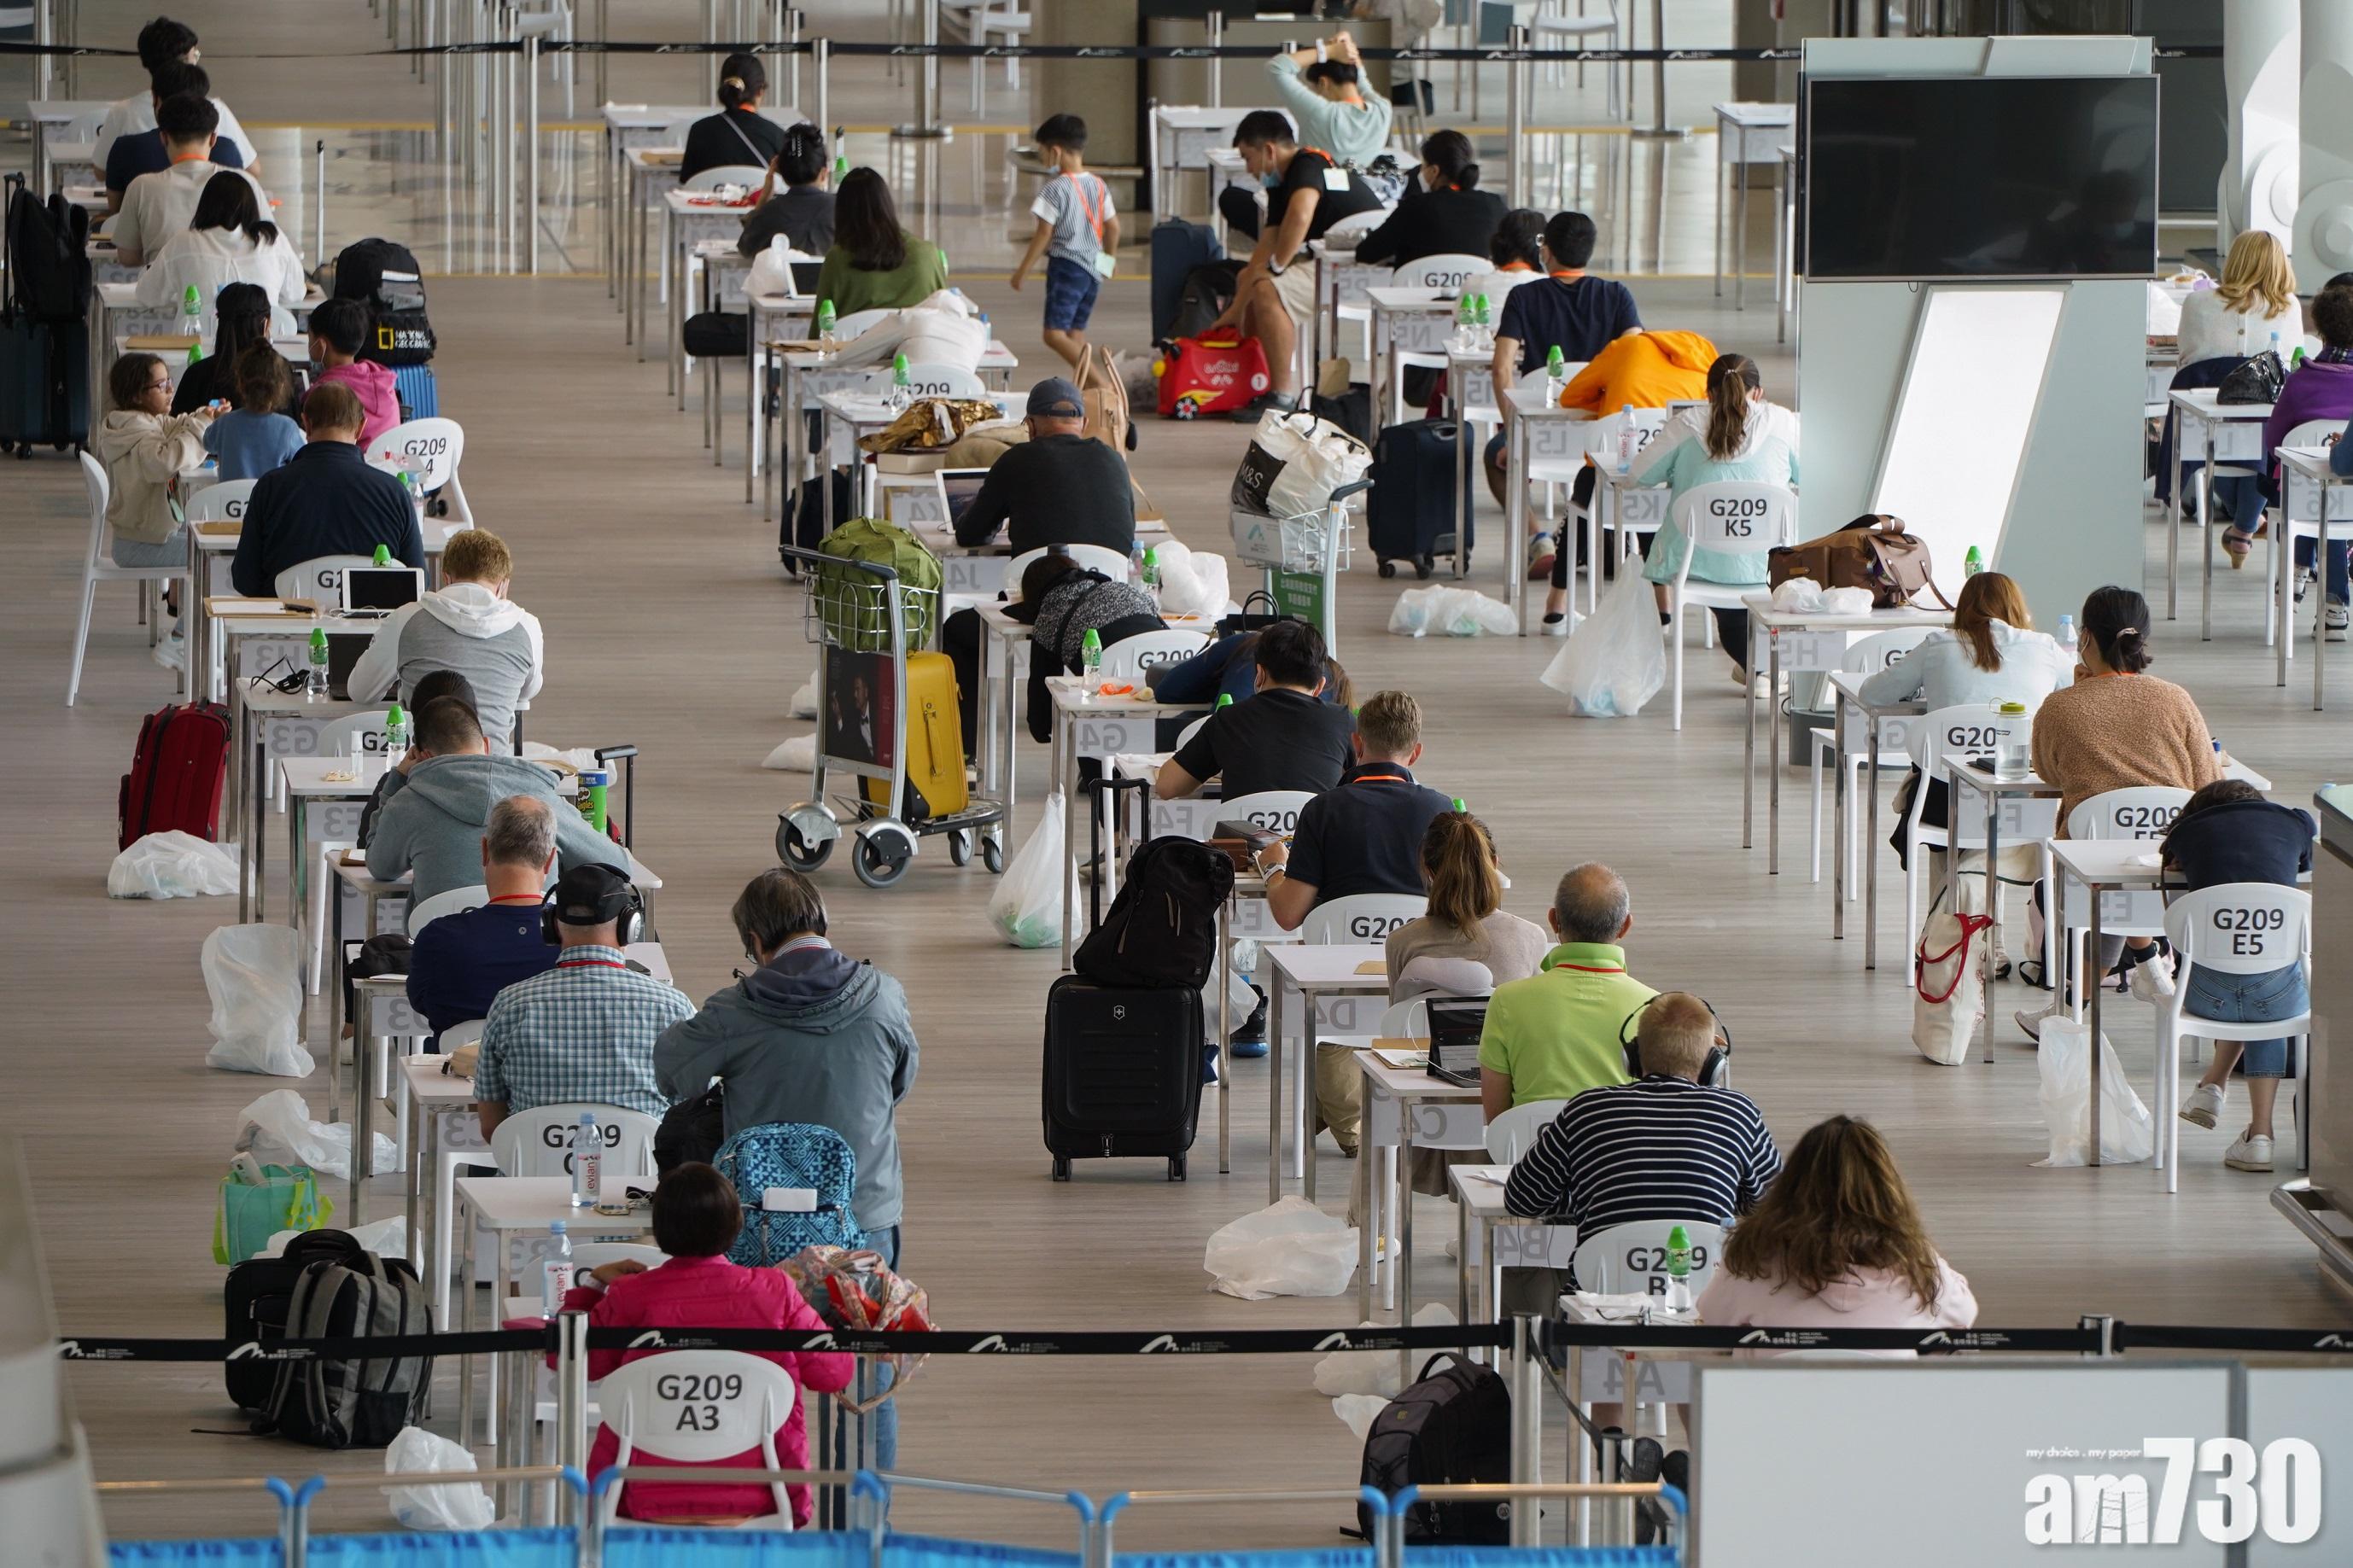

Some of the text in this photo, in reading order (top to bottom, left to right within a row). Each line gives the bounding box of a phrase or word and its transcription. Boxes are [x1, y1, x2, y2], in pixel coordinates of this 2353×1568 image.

[907, 382, 949, 395] 209
[404, 438, 447, 456] G209
[1241, 463, 1264, 489] M&S
[1710, 498, 1767, 516] G209
[1725, 519, 1752, 537] K5
[1947, 726, 1996, 747] G20
[1247, 811, 1299, 832] G20
[1351, 916, 1416, 939] G20
[2213, 908, 2285, 930] G209
[2233, 934, 2264, 955] E5
[543, 1124, 622, 1148] G29
[587, 1162, 595, 1190] evian
[1626, 1246, 1708, 1272] G29
[557, 1273, 566, 1303] evian
[657, 1374, 743, 1401] G209
[675, 1405, 720, 1431] A3
